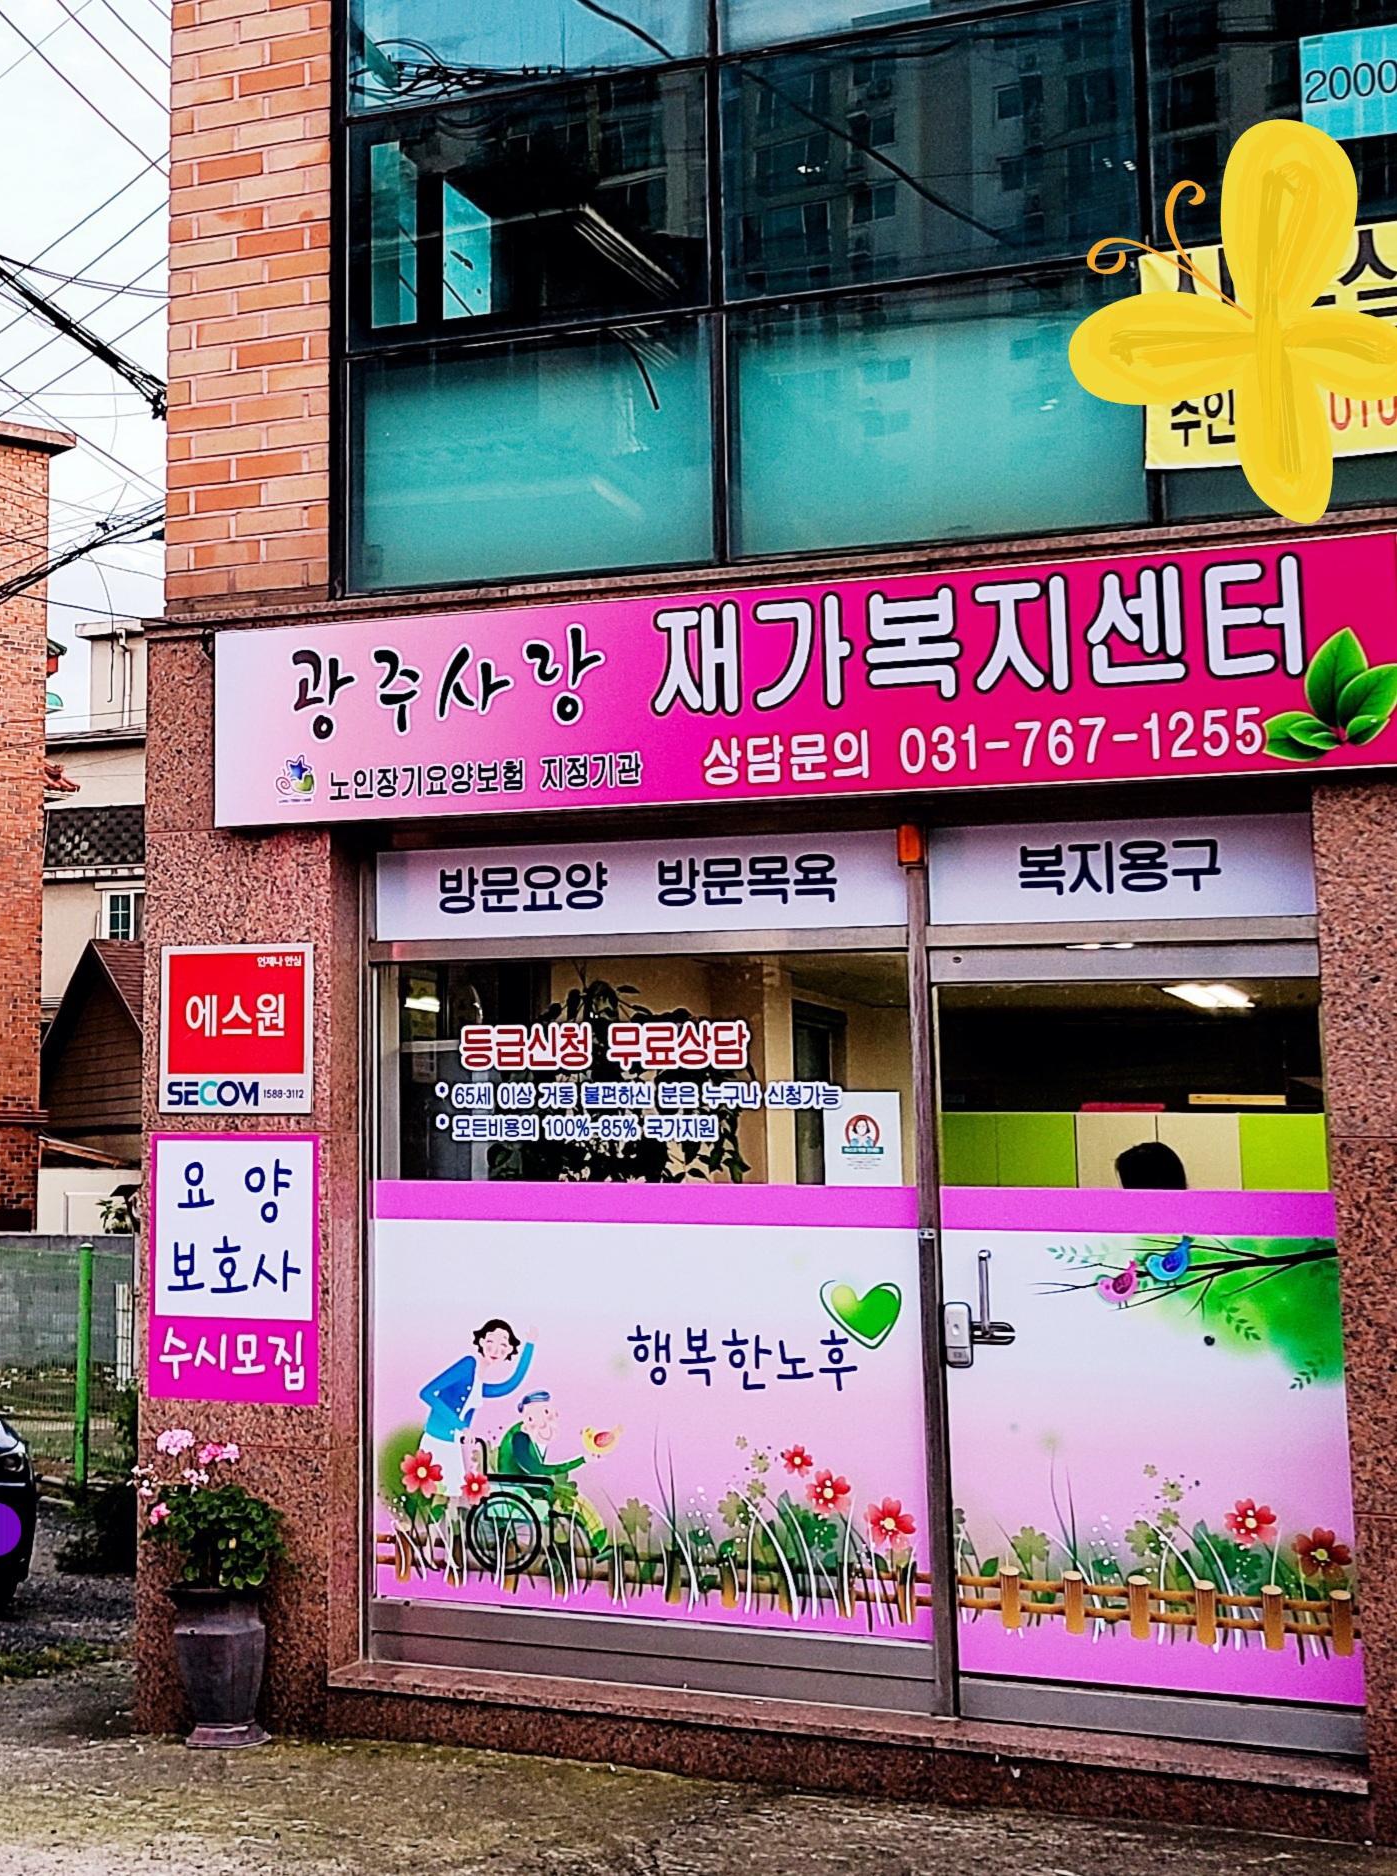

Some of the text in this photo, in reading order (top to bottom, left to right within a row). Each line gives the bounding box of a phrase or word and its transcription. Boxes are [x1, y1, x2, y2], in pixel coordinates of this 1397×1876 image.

[291, 554, 1303, 740] 광주사랑 재가복지센터
[703, 707, 1263, 785] 상담문의 031-767-1255
[328, 753, 641, 800] 노인장기요양보험 지정기관
[439, 853, 838, 913] 방문요양 방문목욕
[1018, 838, 1221, 895] 복지용구
[185, 993, 286, 1037] 에스원
[461, 1022, 749, 1069] 등급신청 무료상담
[167, 1081, 304, 1106] SECOM 1588-3112
[454, 1085, 840, 1106] 65세 이상 거동 불편하신 분은 누구나 신청가능
[455, 1117, 715, 1139] 모든비용의 100%-85% 국가지원
[167, 1236, 301, 1294] 보호사
[159, 1327, 305, 1391] 수시모집
